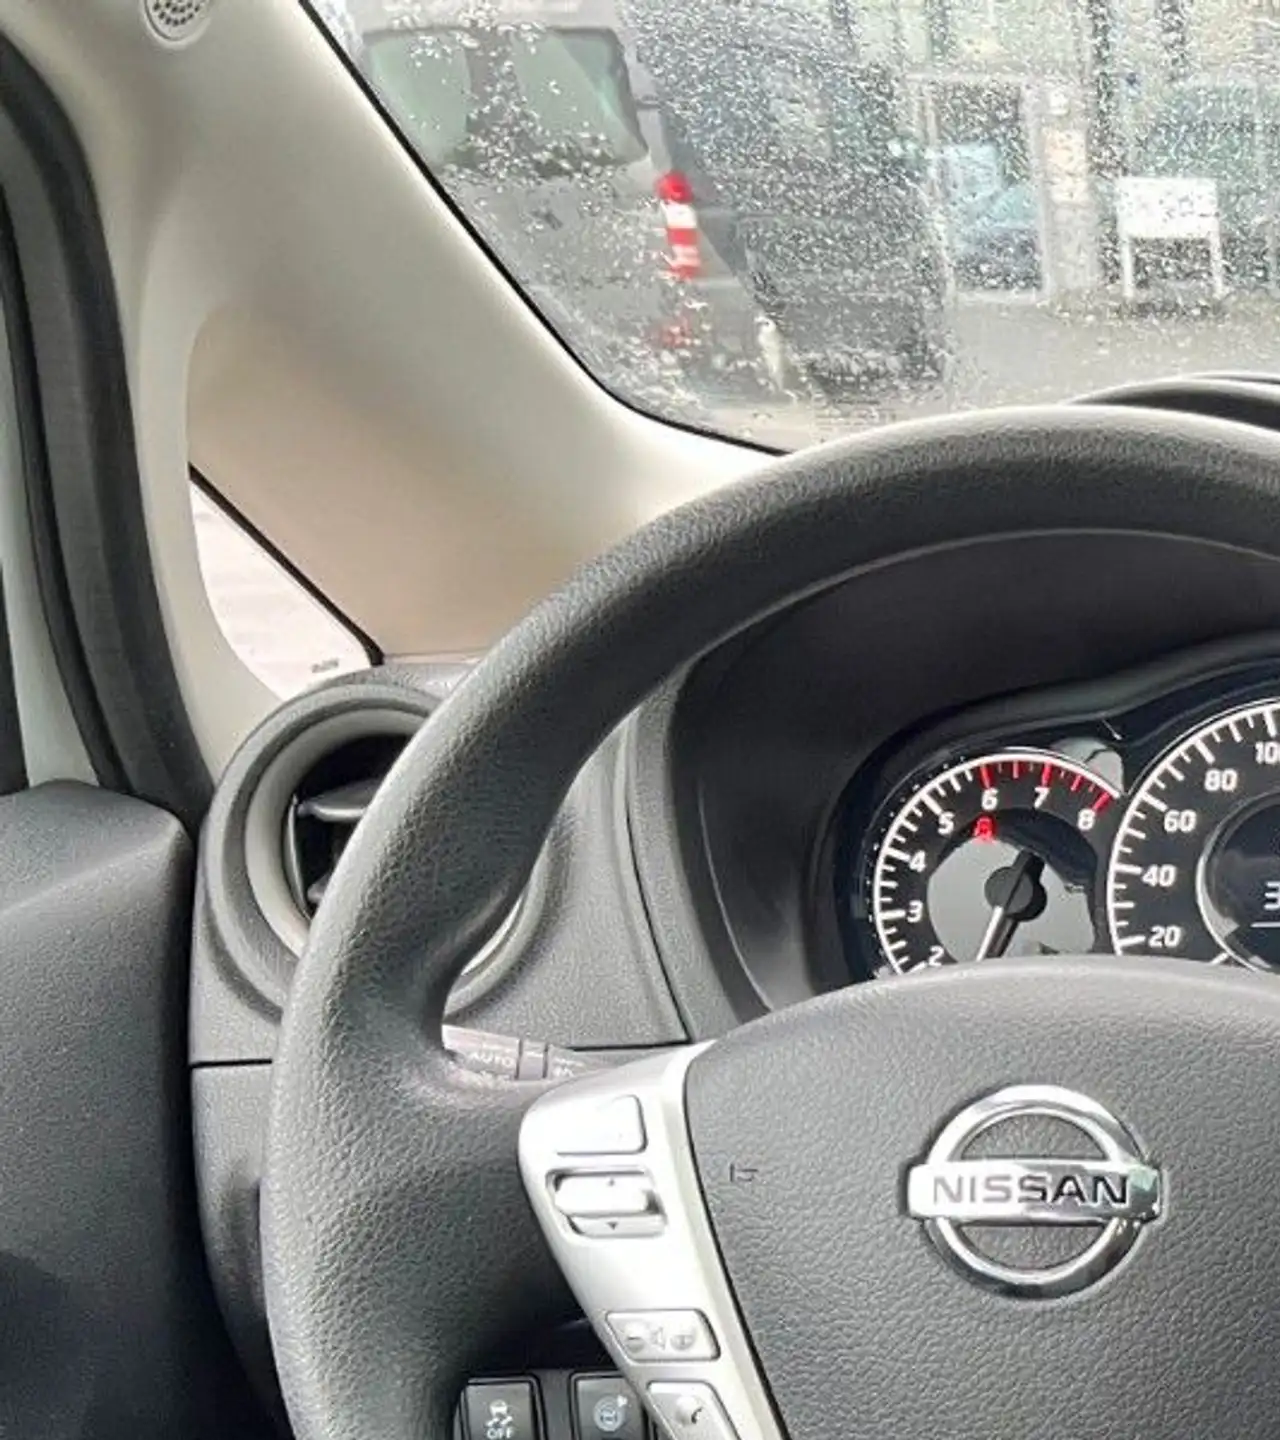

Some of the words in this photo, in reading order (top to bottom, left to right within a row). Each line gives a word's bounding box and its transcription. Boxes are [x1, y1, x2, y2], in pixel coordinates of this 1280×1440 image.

[1204, 768, 1238, 792] 80
[981, 788, 998, 811] 6
[1034, 786, 1050, 808] 7
[937, 812, 955, 835] 5
[1077, 809, 1095, 831] 8
[1163, 809, 1197, 833] 60
[909, 850, 926, 873] 4
[1142, 864, 1177, 887] 40
[907, 900, 923, 923] 3
[1148, 925, 1182, 948] 20
[928, 945, 945, 967] 2
[933, 1174, 1129, 1204] NISSAN
[486, 1427, 514, 1440] OFF
